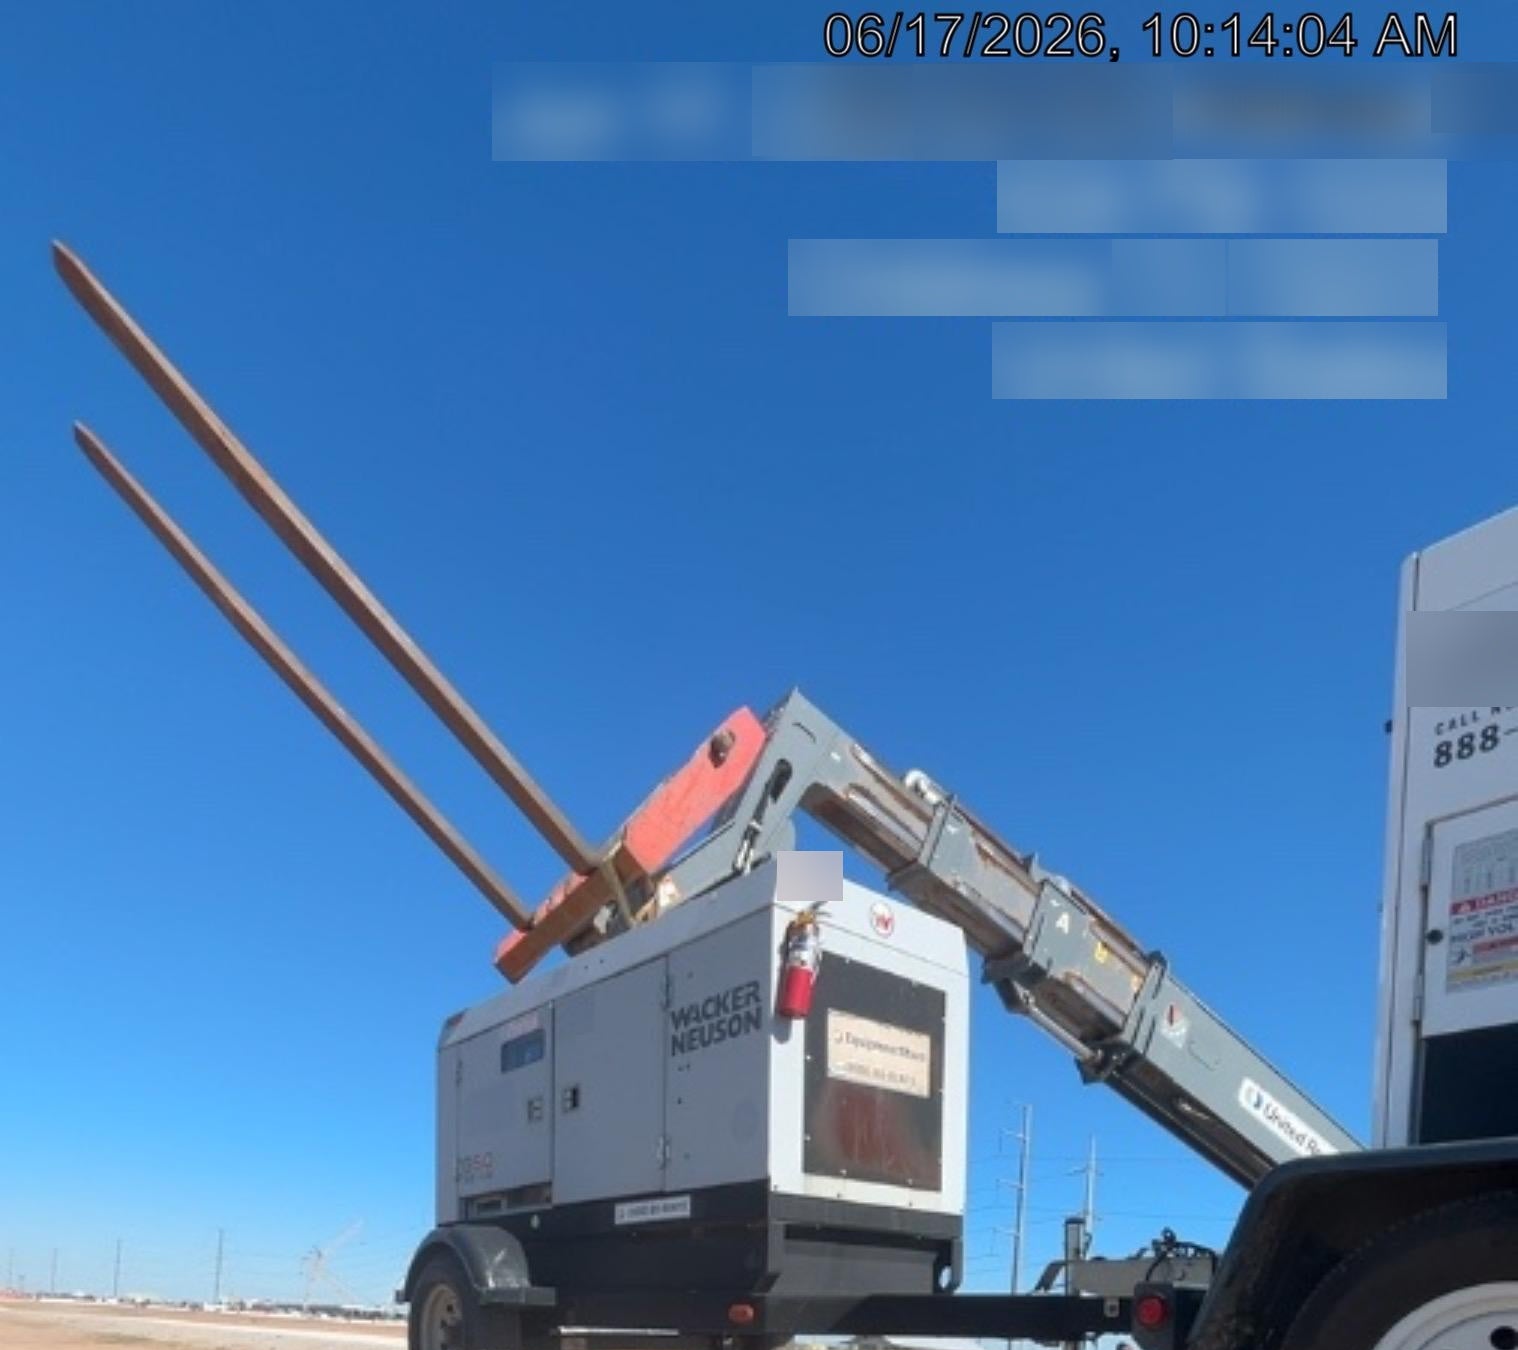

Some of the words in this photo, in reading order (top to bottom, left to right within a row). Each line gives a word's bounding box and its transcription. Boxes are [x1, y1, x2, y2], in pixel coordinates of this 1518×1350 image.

[1435, 710, 1480, 736] CALL
[671, 980, 761, 1031] WACKER
[671, 1005, 762, 1057] NEUSON
